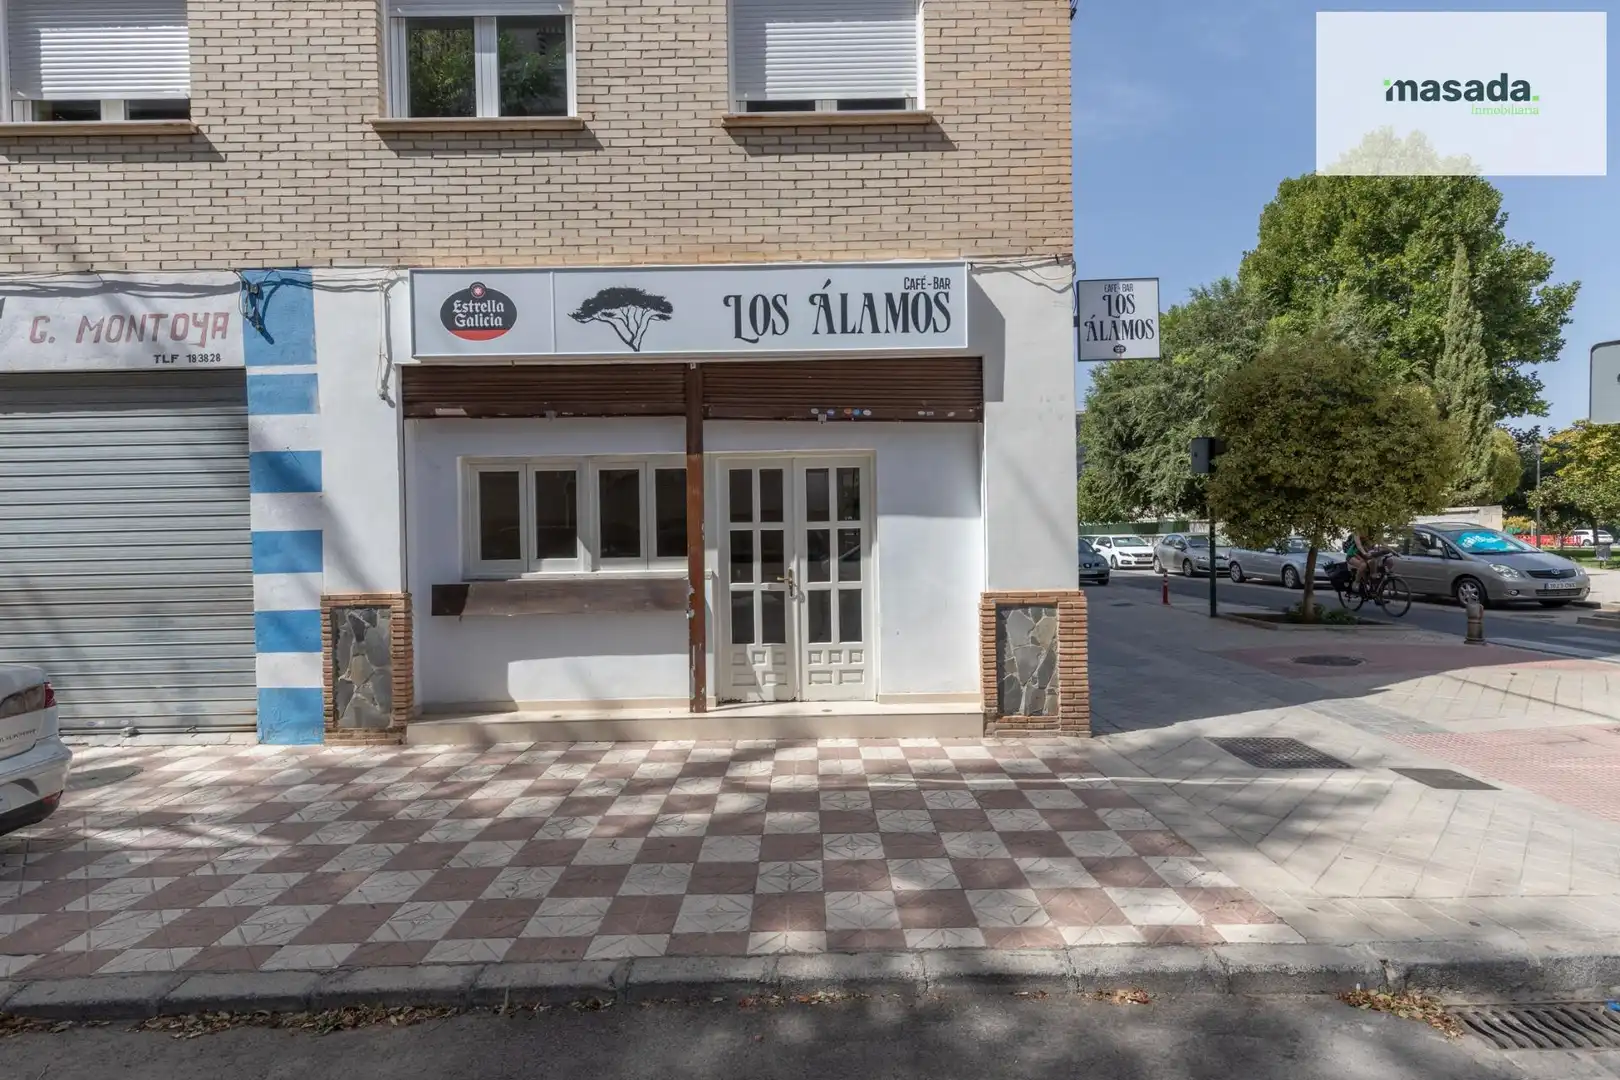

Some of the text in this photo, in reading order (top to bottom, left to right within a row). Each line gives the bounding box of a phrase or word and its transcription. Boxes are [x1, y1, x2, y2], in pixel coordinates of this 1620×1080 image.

[452, 299, 505, 313] Estrella
[723, 278, 951, 344] LOS ÁLAMOS
[1102, 293, 1136, 318] LOS
[454, 313, 503, 327] Galicia
[1084, 314, 1155, 341] ÁLAMOS
[153, 353, 221, 364] TLF 183828
